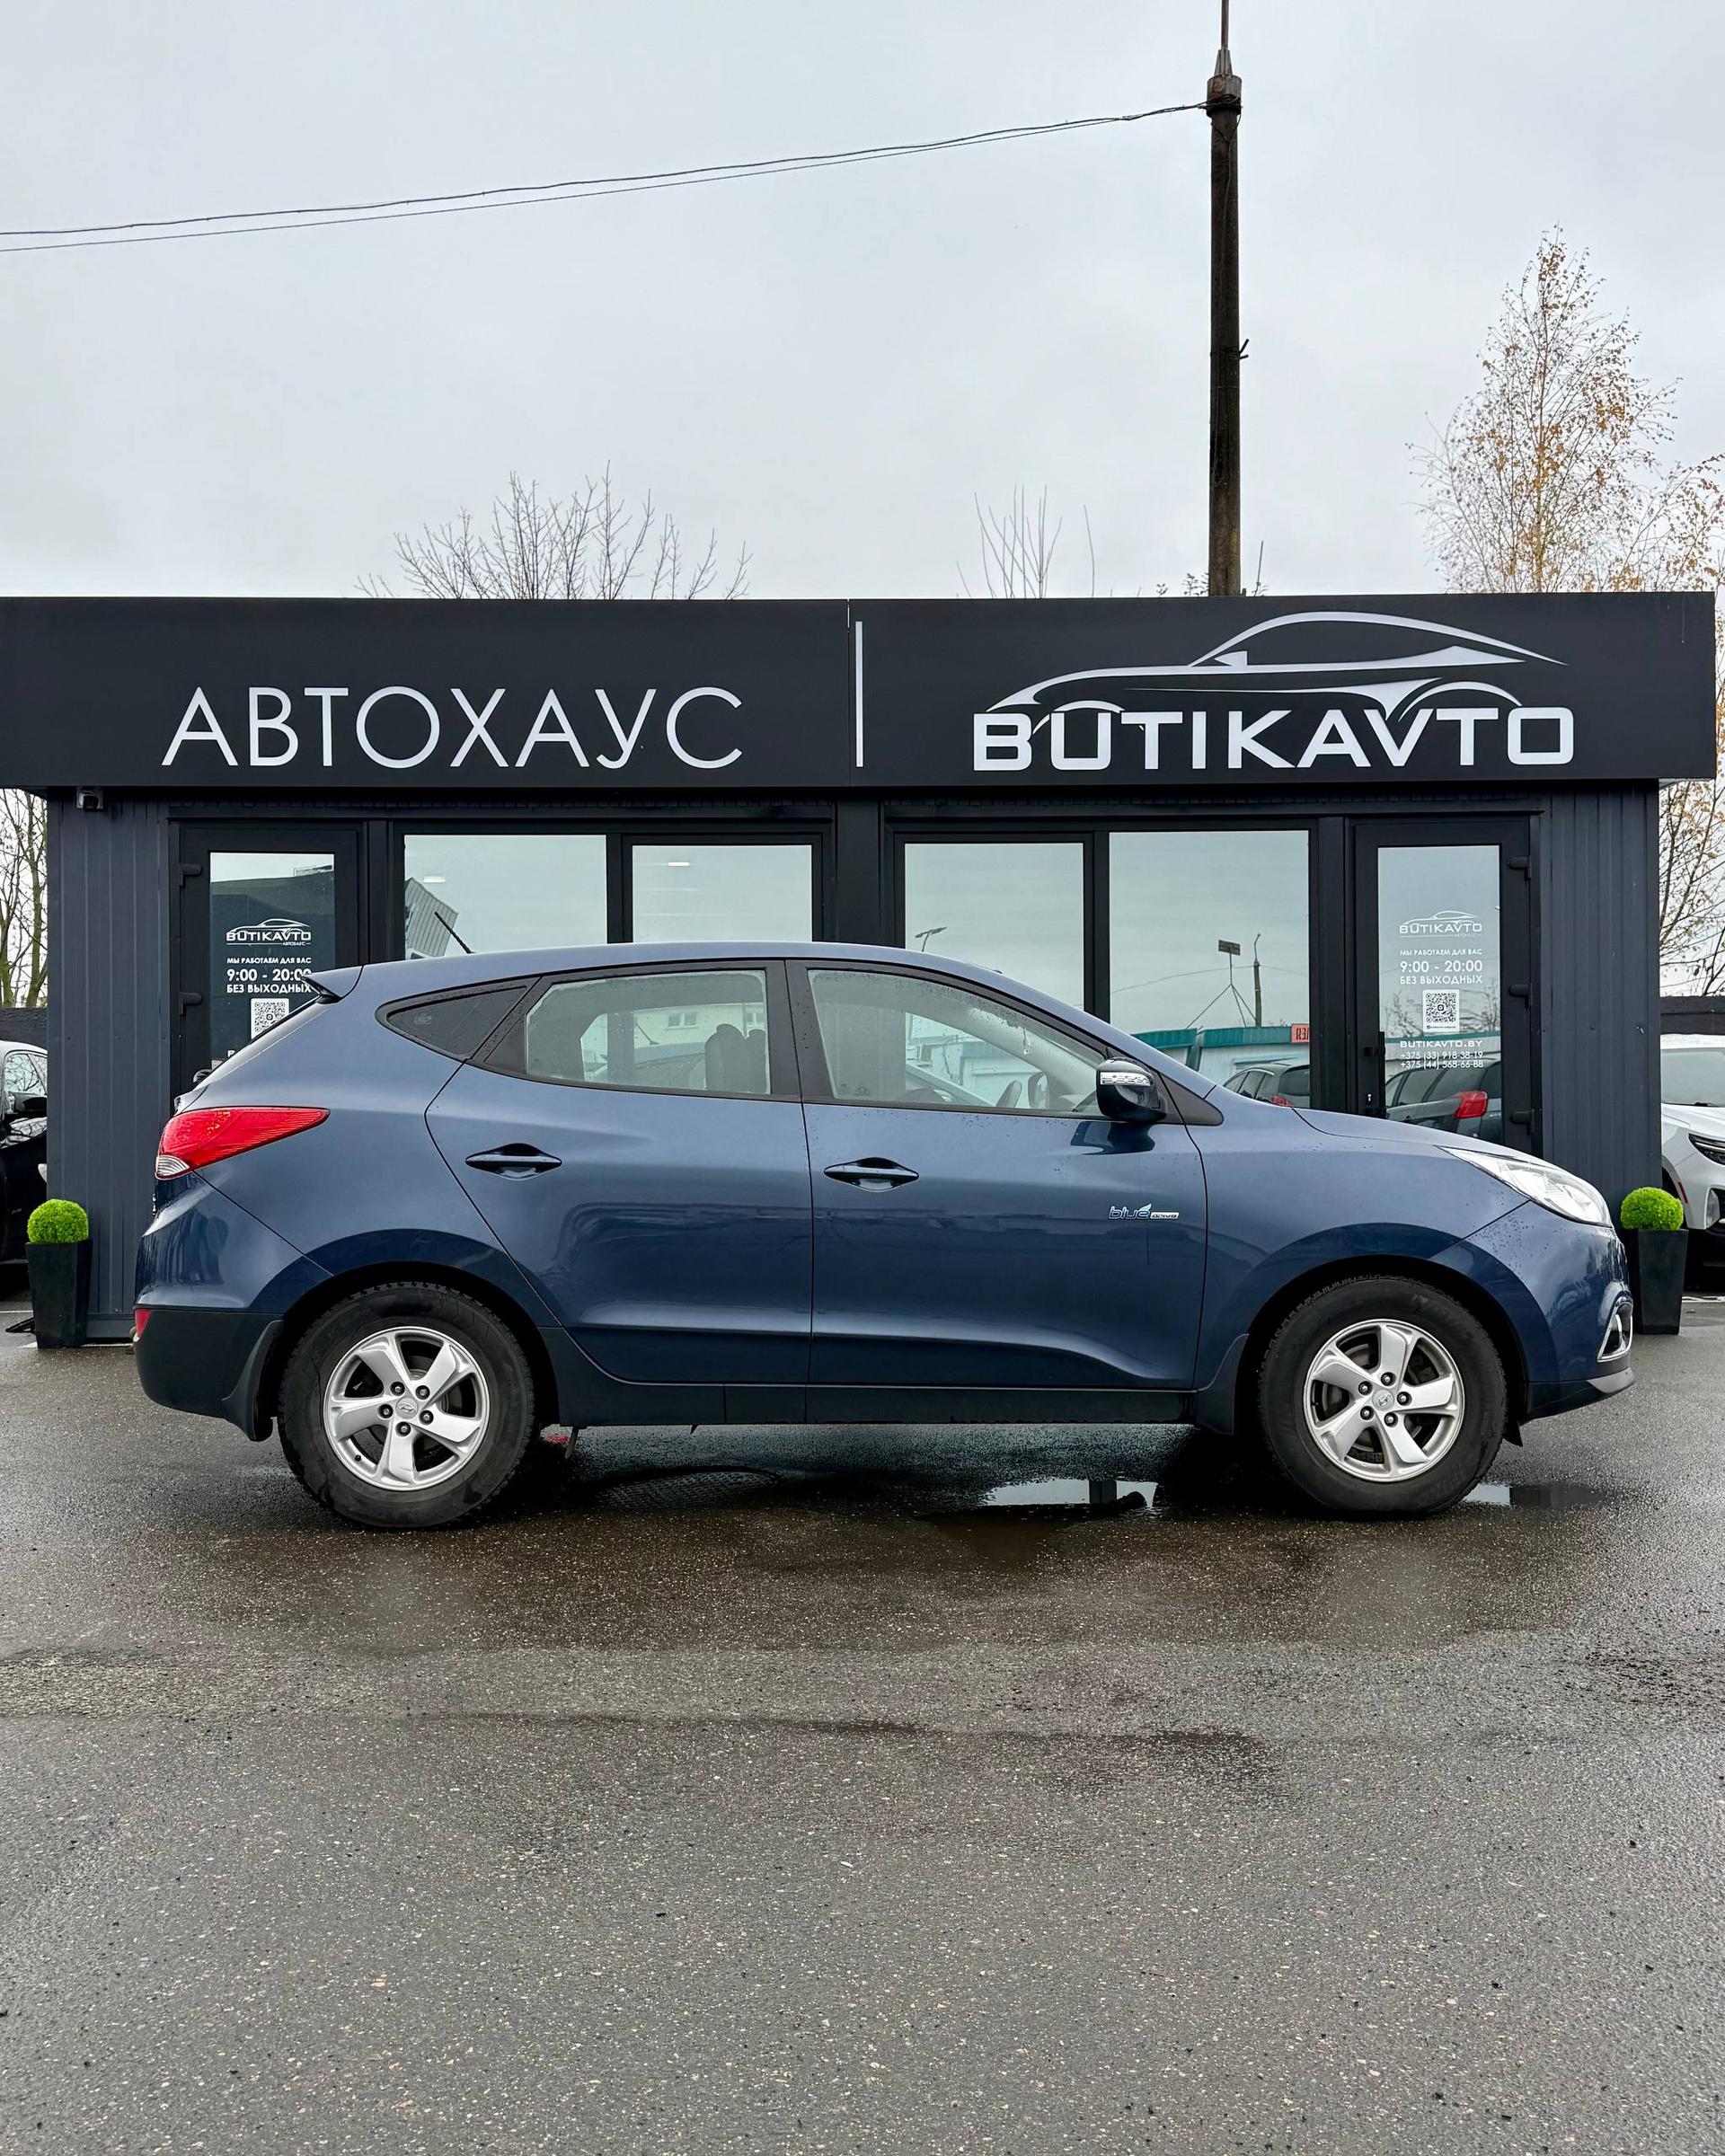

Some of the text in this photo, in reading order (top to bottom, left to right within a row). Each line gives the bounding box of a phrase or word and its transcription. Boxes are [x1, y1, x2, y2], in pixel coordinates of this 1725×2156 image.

[162, 686, 743, 770] АВТОХАУС
[972, 706, 1574, 772] BUTIKAVTO
[1399, 923, 1482, 934] BUTIKAVTO
[226, 932, 312, 941] BUTIKAVTO
[1400, 961, 1429, 973] 9:00
[1444, 960, 1482, 972] 20:00
[226, 968, 258, 982] 9:00
[1400, 976, 1482, 985] БЕЗ ВЫХОДНЫХ
[226, 984, 312, 994] БЕЗ ВЫХОДНЫХ
[1400, 1040, 1483, 1048] BUTIKAVTO.BY
[1400, 1052, 1421, 1060] +375
[1423, 1051, 1439, 1062] (33)
[1400, 1061, 1421, 1069] +375
[1423, 1060, 1439, 1070] (44)
[1109, 1206, 1151, 1219] blue
